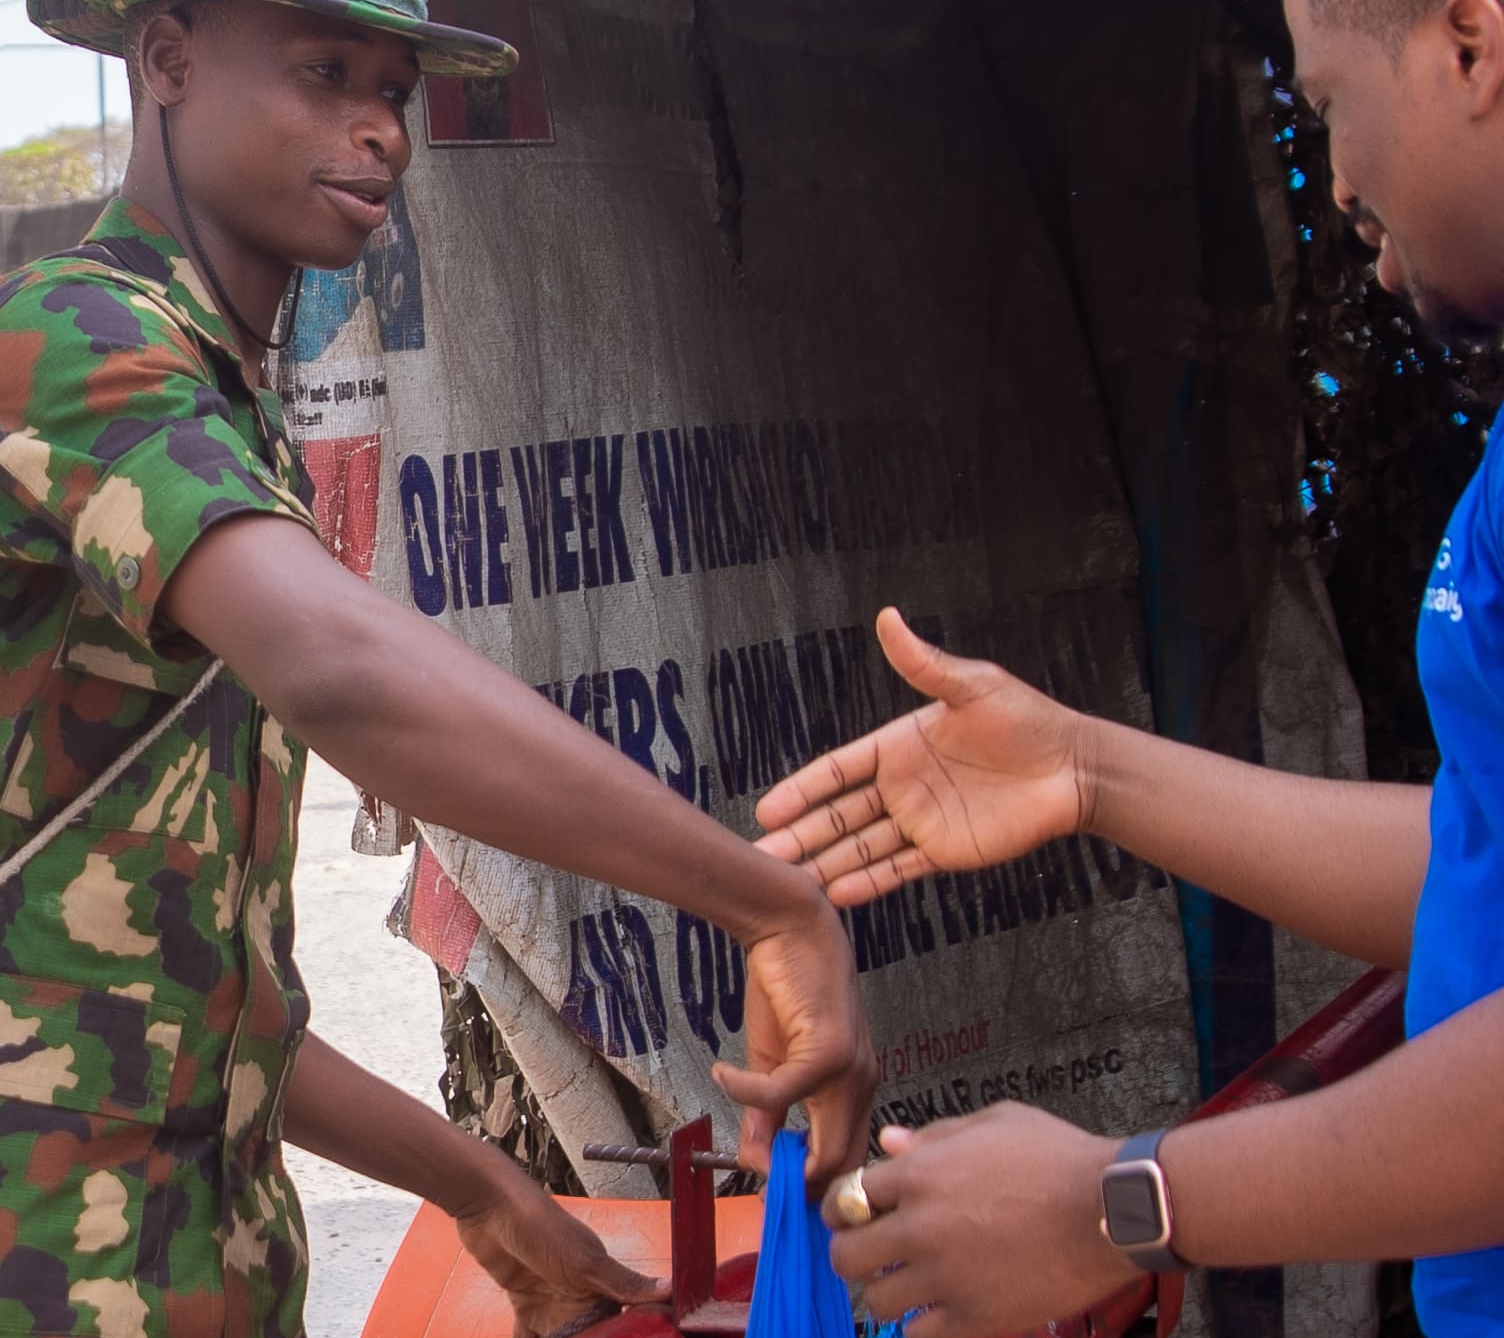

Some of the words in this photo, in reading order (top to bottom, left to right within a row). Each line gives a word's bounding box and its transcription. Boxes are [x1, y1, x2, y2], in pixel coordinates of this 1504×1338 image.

[400, 454, 512, 617] ONE
[915, 1019, 991, 1070] Honour
[1071, 1048, 1124, 1094] psc
